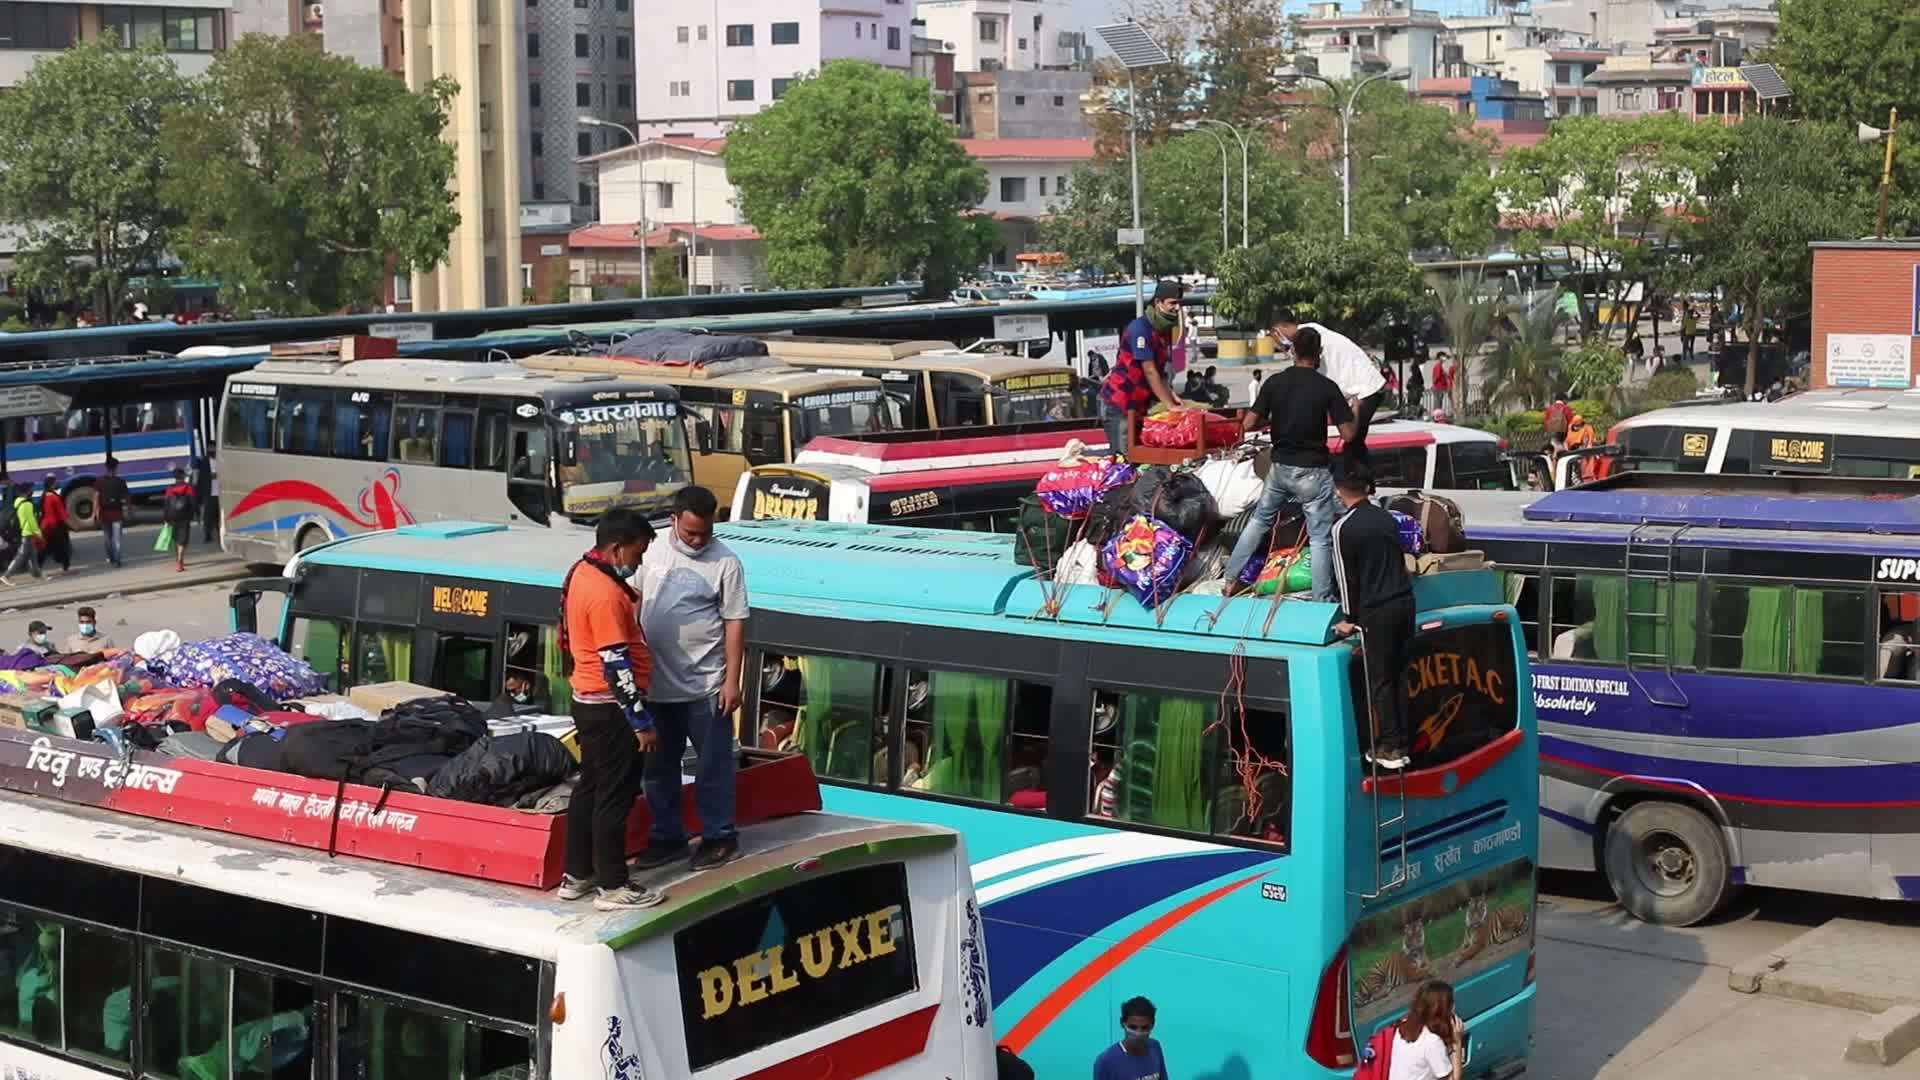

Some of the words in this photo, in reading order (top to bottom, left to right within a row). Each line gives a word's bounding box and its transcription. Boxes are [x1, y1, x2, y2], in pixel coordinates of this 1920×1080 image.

[1407, 652, 1461, 698] CKET
[1537, 674, 1560, 691] FIRST
[1560, 676, 1594, 694] EDITION
[1595, 679, 1630, 697] SPECIAL
[697, 904, 902, 1020] DELUXE
